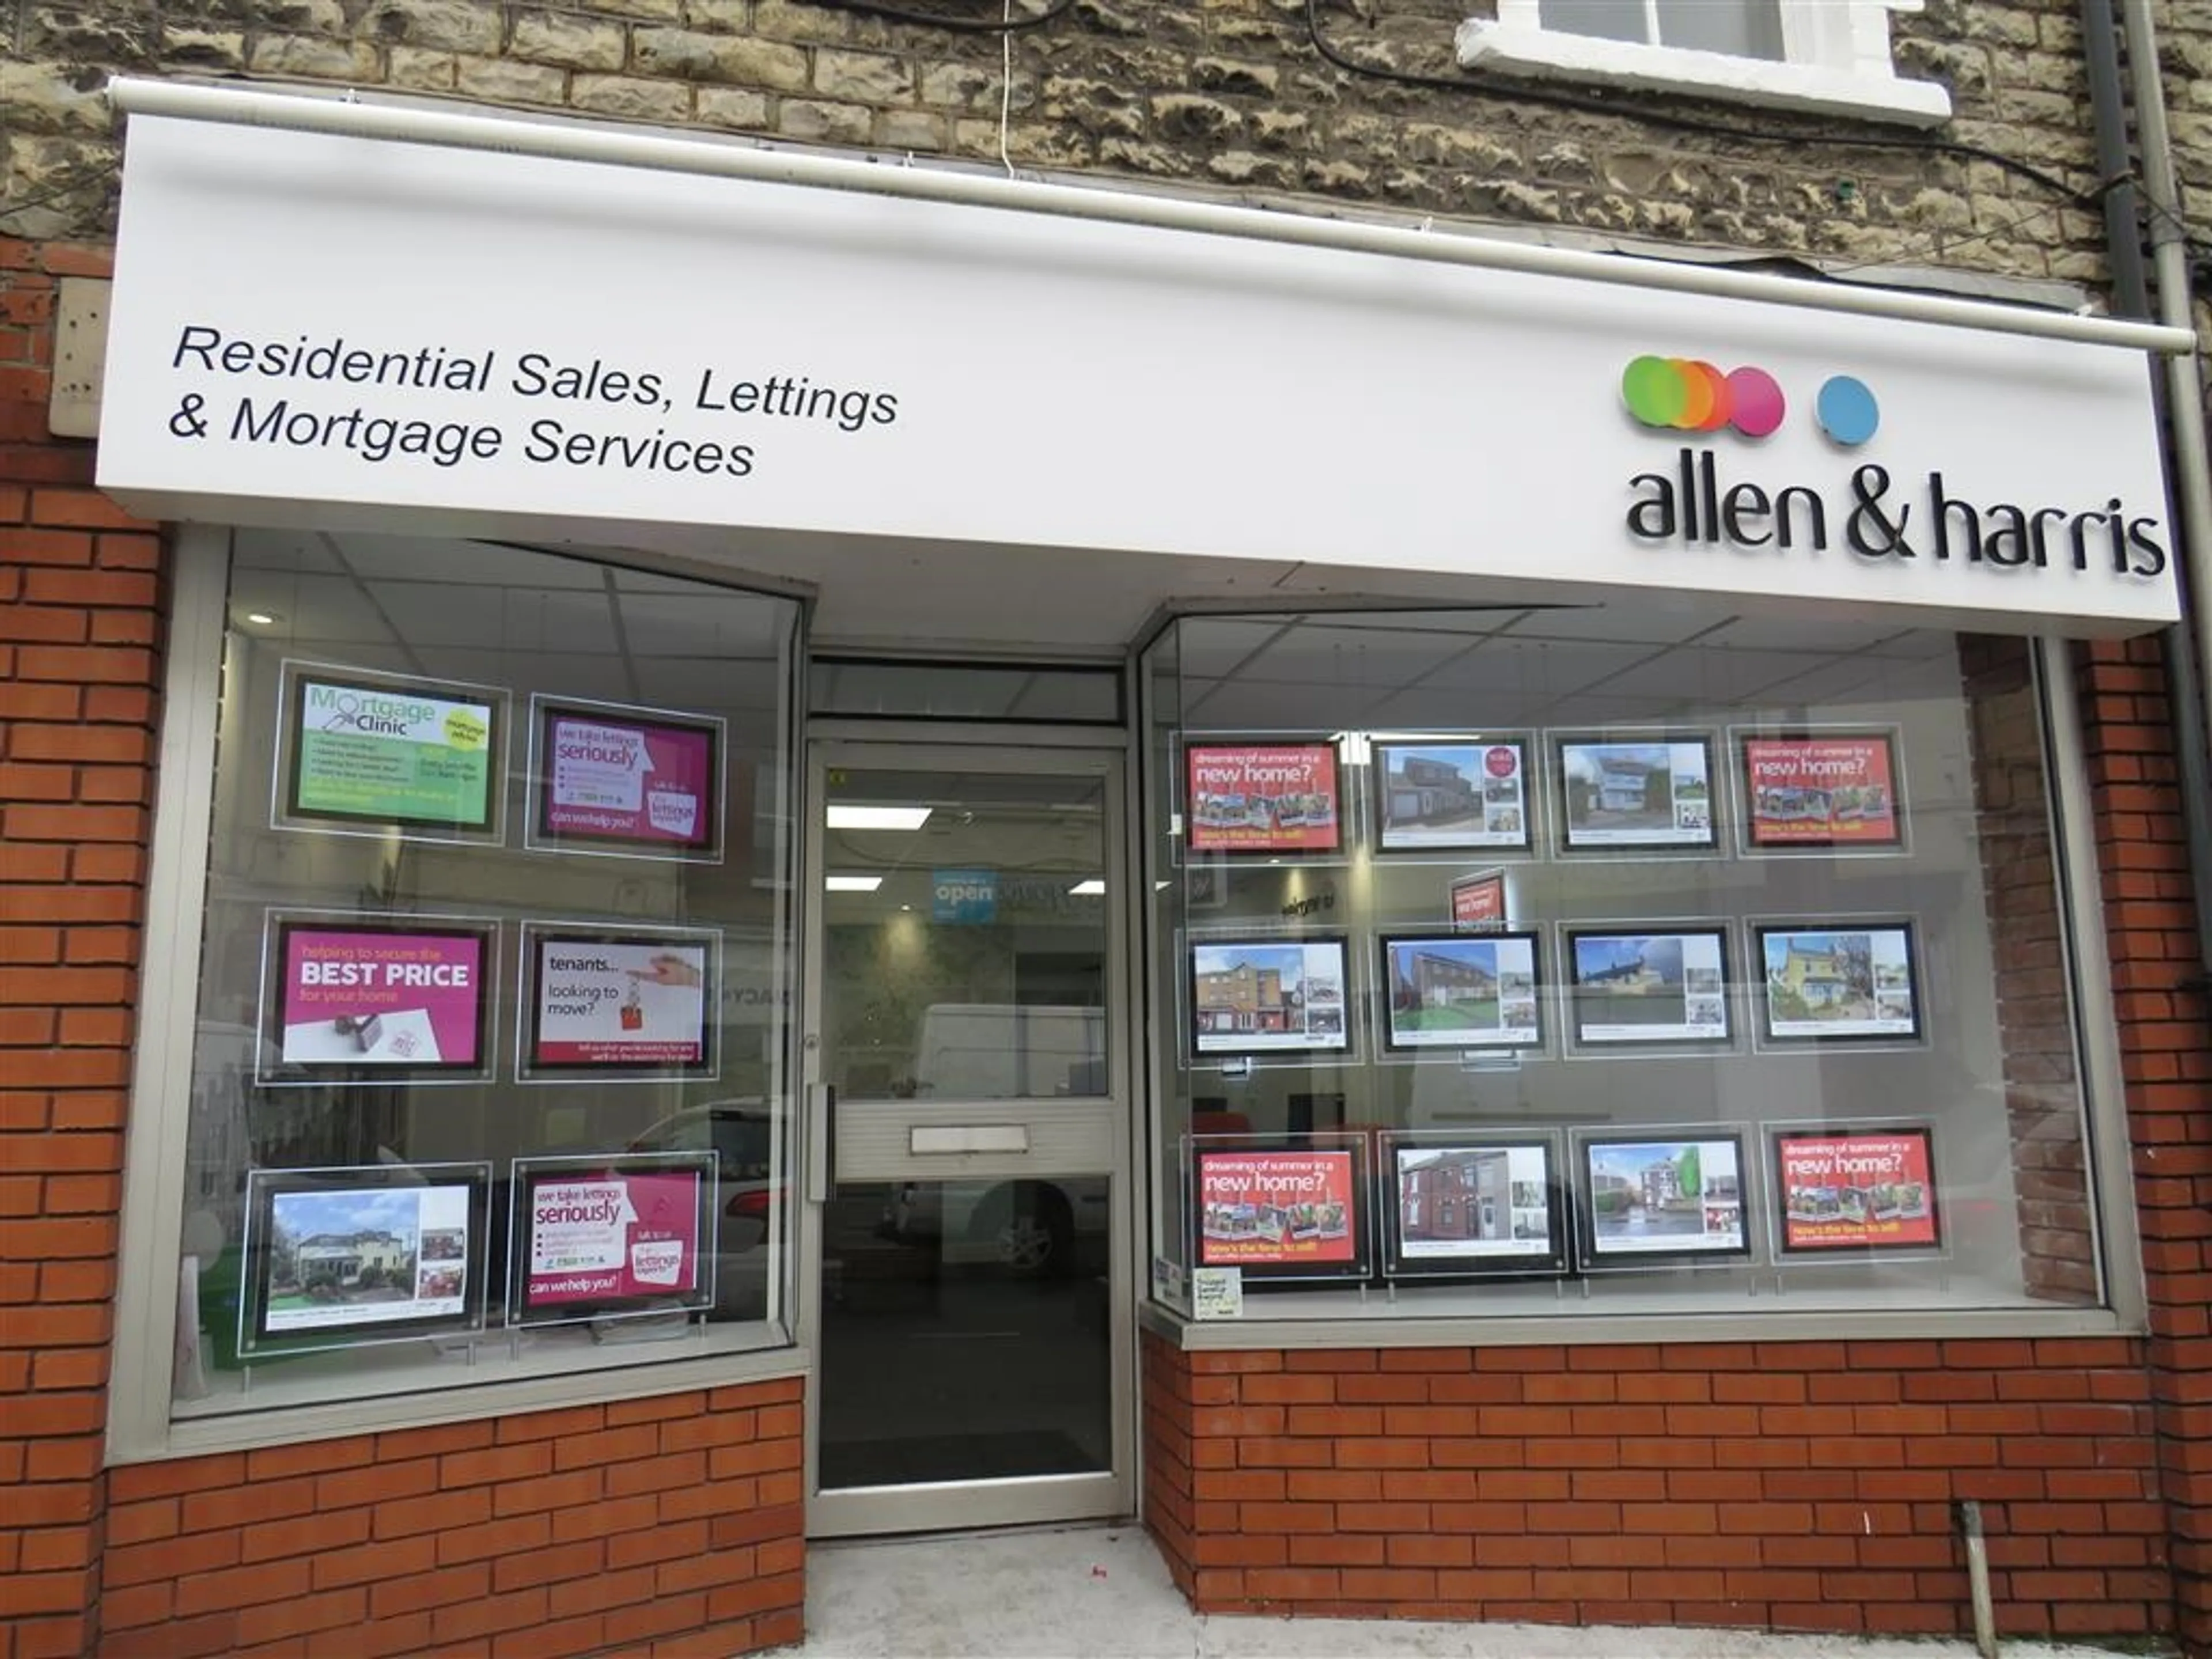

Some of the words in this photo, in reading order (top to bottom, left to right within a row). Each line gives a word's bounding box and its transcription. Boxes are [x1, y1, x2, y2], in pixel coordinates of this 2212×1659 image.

[173, 326, 494, 392] Residential
[512, 354, 672, 414] Sales,
[696, 369, 899, 431] Lettings
[169, 393, 208, 438] &
[230, 397, 502, 467] Mortgage
[524, 419, 755, 476] Services
[1626, 447, 1828, 551] allen
[1847, 463, 1918, 558] &
[1928, 471, 2166, 575] harris
[356, 714, 408, 736] Clinic
[558, 740, 638, 771] seriously
[1196, 767, 1242, 783] new
[1244, 764, 1312, 783] home?
[1755, 762, 1797, 777] new
[1801, 757, 1866, 775] home?
[935, 884, 993, 906] open
[302, 945, 354, 962] helping
[300, 961, 378, 985] BEST
[385, 963, 469, 987] PRICE
[299, 989, 317, 1002] for
[548, 984, 601, 1002] looking
[603, 986, 619, 999] to
[548, 1001, 595, 1016] move?
[1787, 1158, 1832, 1176] new
[1835, 1153, 1902, 1173] home?
[1205, 1176, 1252, 1192] new
[1254, 1171, 1325, 1192] home?
[536, 1199, 621, 1226] seriously
